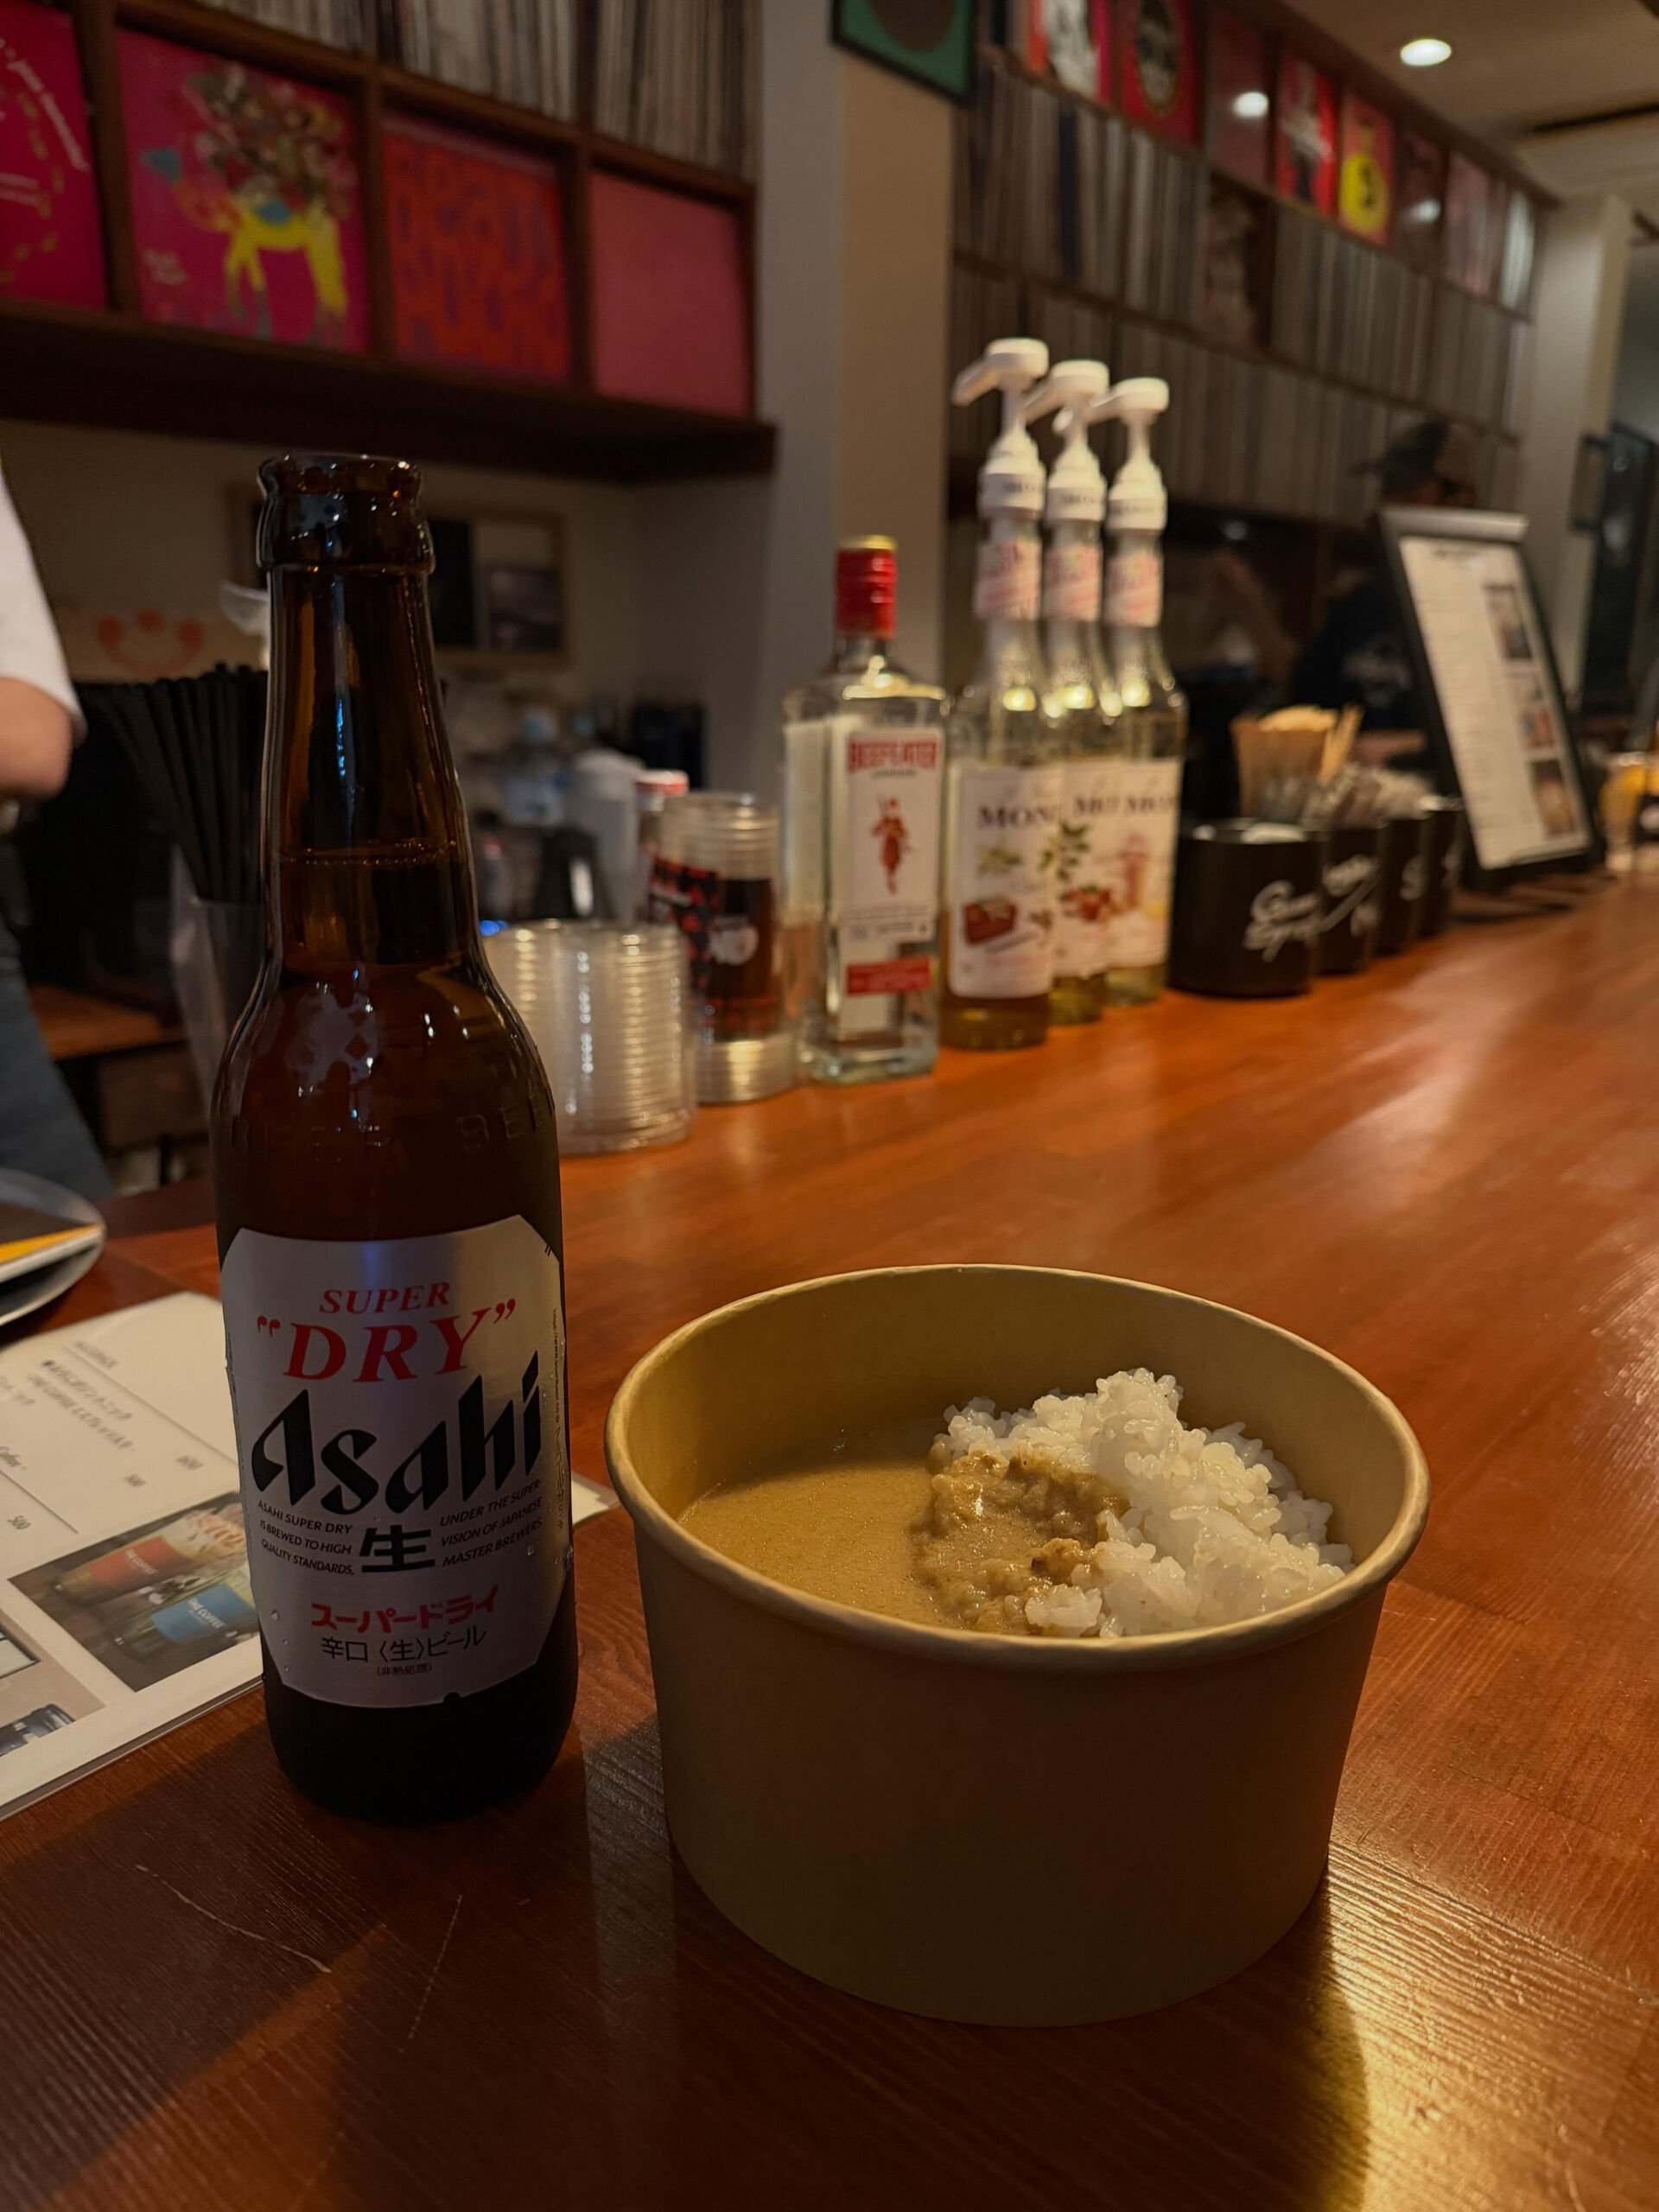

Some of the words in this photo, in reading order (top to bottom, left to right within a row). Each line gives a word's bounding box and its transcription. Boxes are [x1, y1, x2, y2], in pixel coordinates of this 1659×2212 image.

[319, 1282, 450, 1314] SUPER
[251, 1351, 542, 1516] Asahi
[258, 1500, 283, 1520] ASAHI
[285, 1513, 322, 1531] SUPER
[325, 1522, 353, 1534] DRY
[440, 1506, 485, 1527] UNDER
[487, 1496, 510, 1512] THE
[442, 1528, 481, 1547] VISION
[482, 1521, 498, 1535] OF
[499, 1497, 542, 1529] JAPANESE
[260, 1520, 266, 1529] IS
[267, 1523, 302, 1546] BREWED
[304, 1539, 319, 1550] TO
[321, 1542, 352, 1554] HIGH
[262, 1539, 293, 1561] QUALITY
[359, 1525, 435, 1573] 生
[442, 1543, 493, 1567] MASTER
[311, 1585, 499, 1633] スーパードライ
